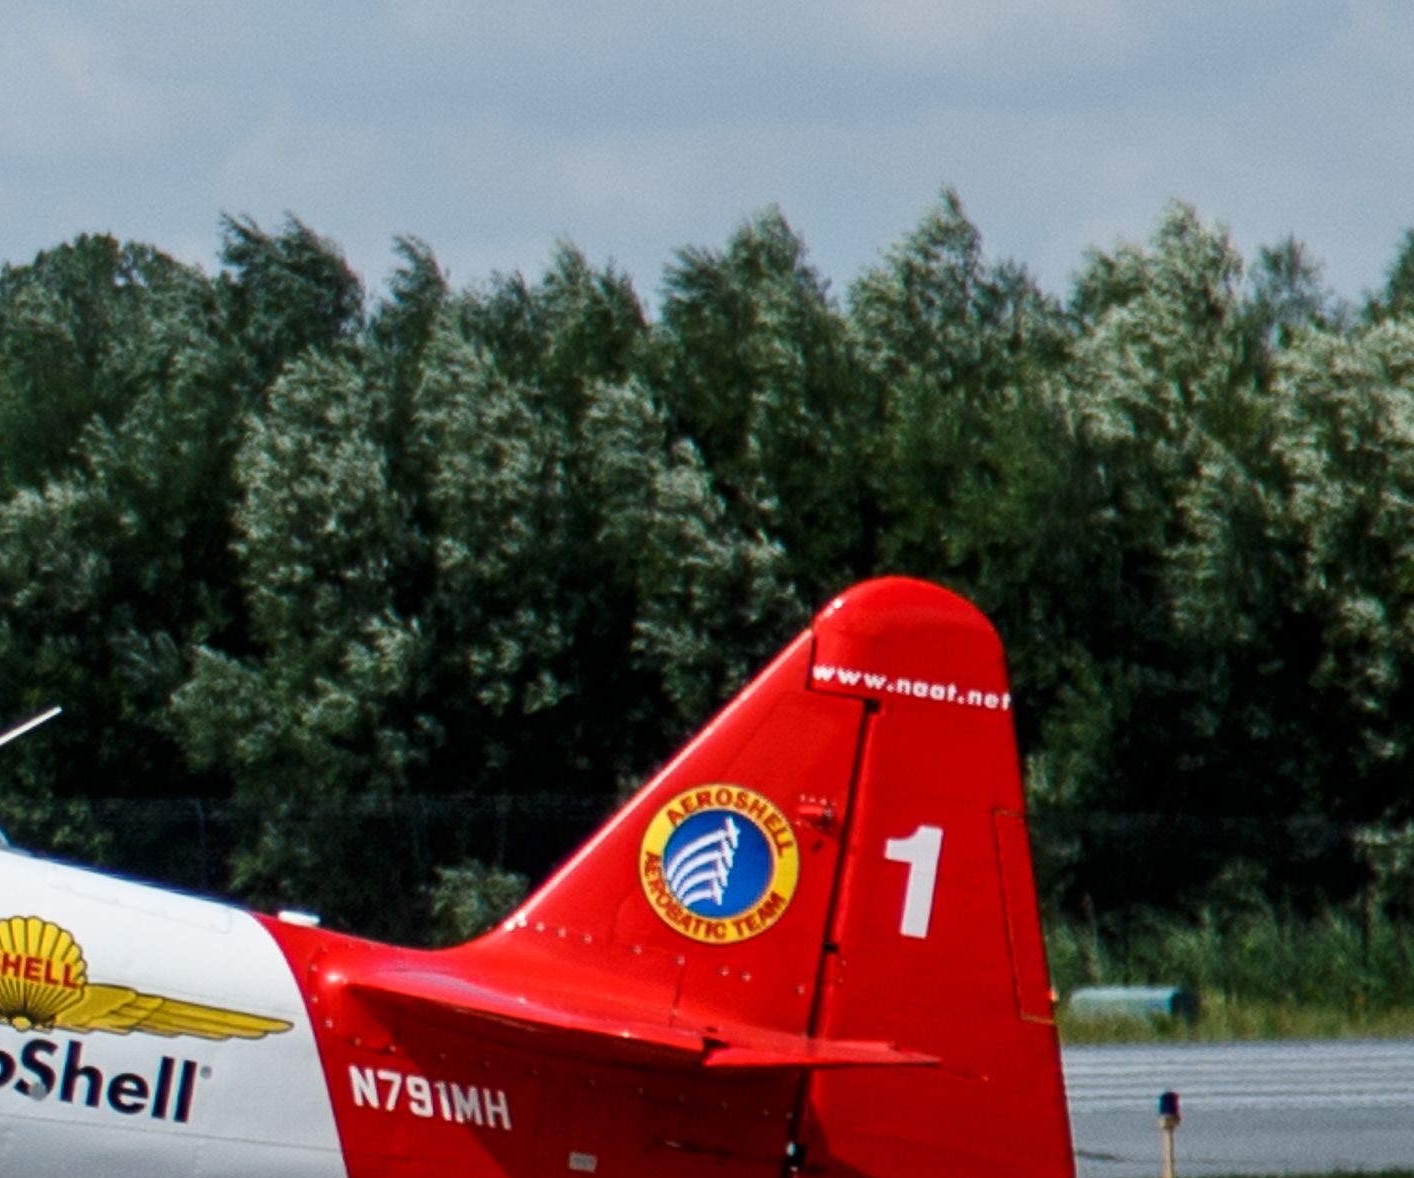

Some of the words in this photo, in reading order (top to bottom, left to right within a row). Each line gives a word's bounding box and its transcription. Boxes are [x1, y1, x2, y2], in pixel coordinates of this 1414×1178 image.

[812, 664, 1011, 710] www.naat.net
[666, 788, 793, 858] AEROSHELL
[644, 851, 727, 940] AEROBATIC
[730, 891, 787, 937] TEAM
[883, 824, 943, 939] 1
[347, 1064, 512, 1132] N791MH
